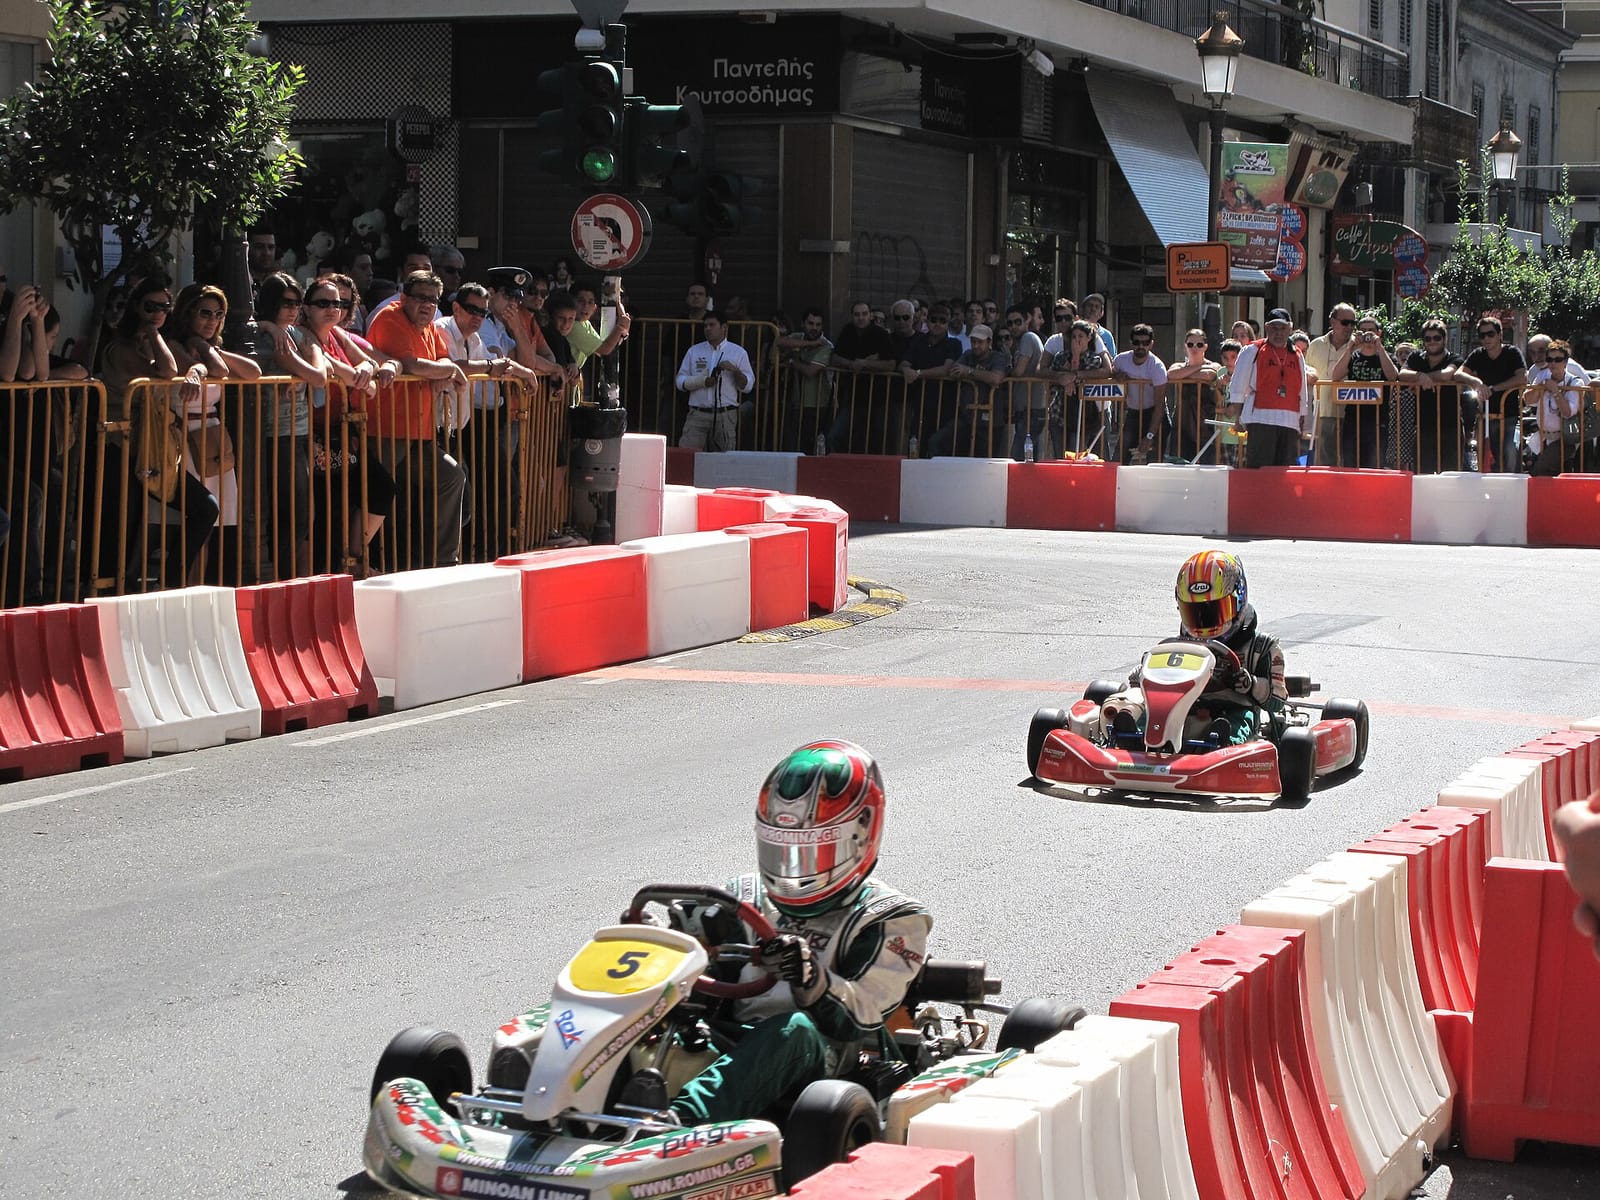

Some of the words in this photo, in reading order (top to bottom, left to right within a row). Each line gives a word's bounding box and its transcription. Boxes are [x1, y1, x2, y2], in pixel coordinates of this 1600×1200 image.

[713, 57, 814, 80] Παντελής
[1178, 253, 1186, 264] P
[1082, 385, 1123, 397] ΕΛΠΑ
[1338, 388, 1378, 400] ΕΛΠΑ
[1190, 583, 1208, 592] Arai
[1167, 651, 1185, 667] 6
[606, 951, 651, 980] 5
[582, 997, 668, 1079] WWW.ROMINA.GR
[456, 1151, 577, 1177] WWW.ROMINA.GR
[629, 1153, 757, 1199] WWW.ROMINA.GR
[462, 1177, 535, 1200] MINOAN
